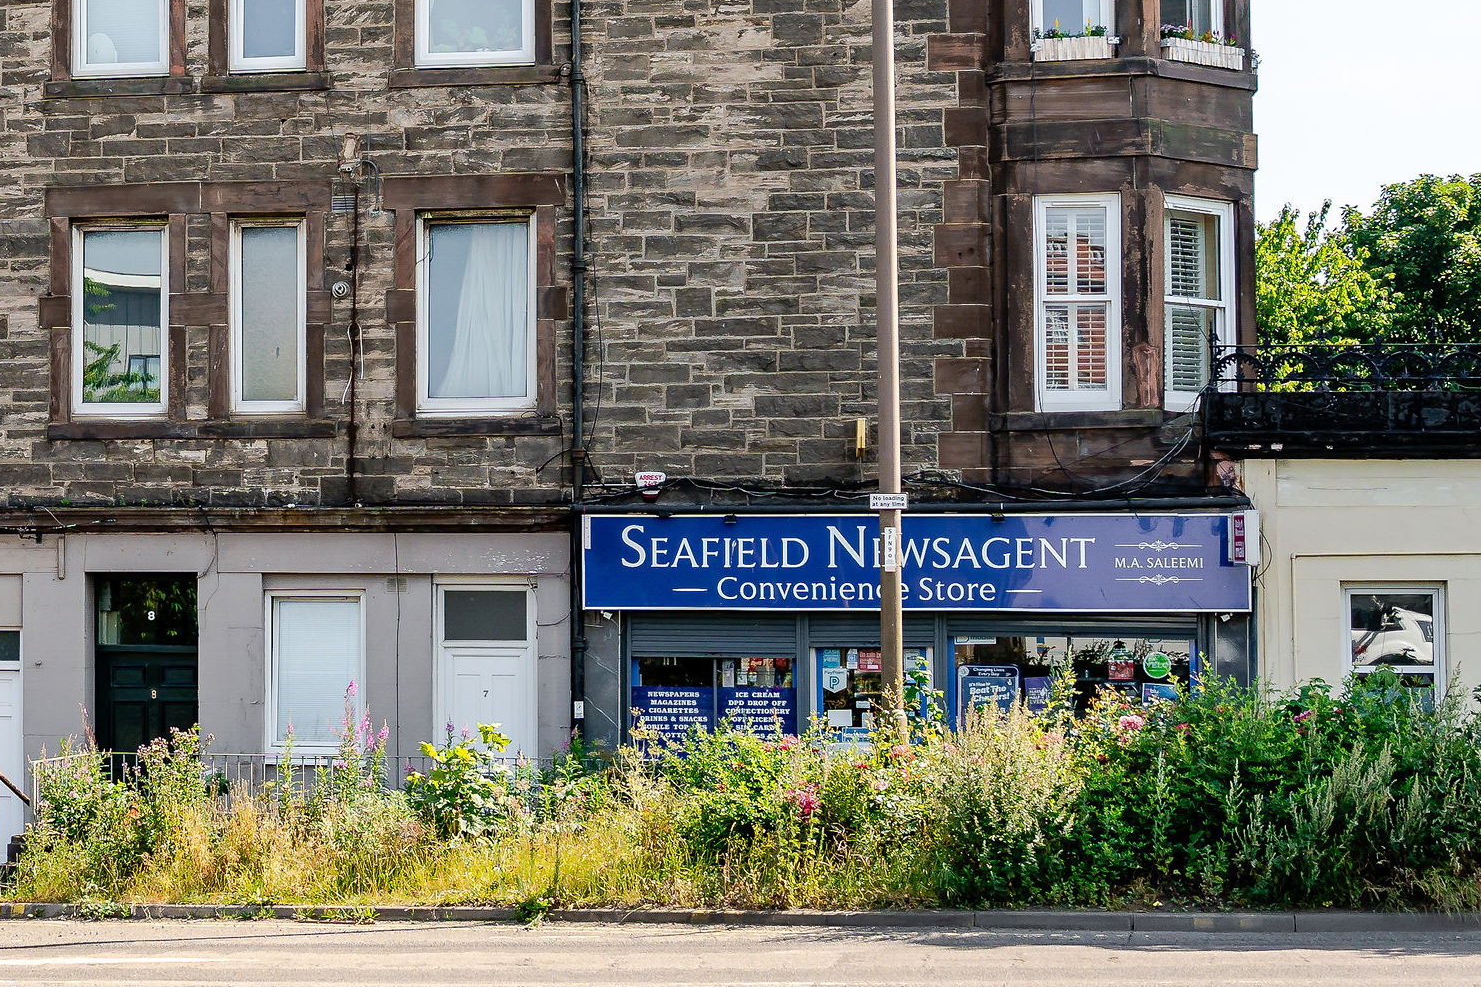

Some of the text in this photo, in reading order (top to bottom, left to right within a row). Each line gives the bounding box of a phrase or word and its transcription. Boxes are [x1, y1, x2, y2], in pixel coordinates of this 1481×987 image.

[621, 524, 810, 568] SEAFIELD
[1114, 557, 1204, 569] M.A. SALEEMI
[918, 577, 996, 602] Store
[147, 610, 156, 620] 8
[151, 689, 157, 699] 8
[969, 685, 1007, 695] Beat The
